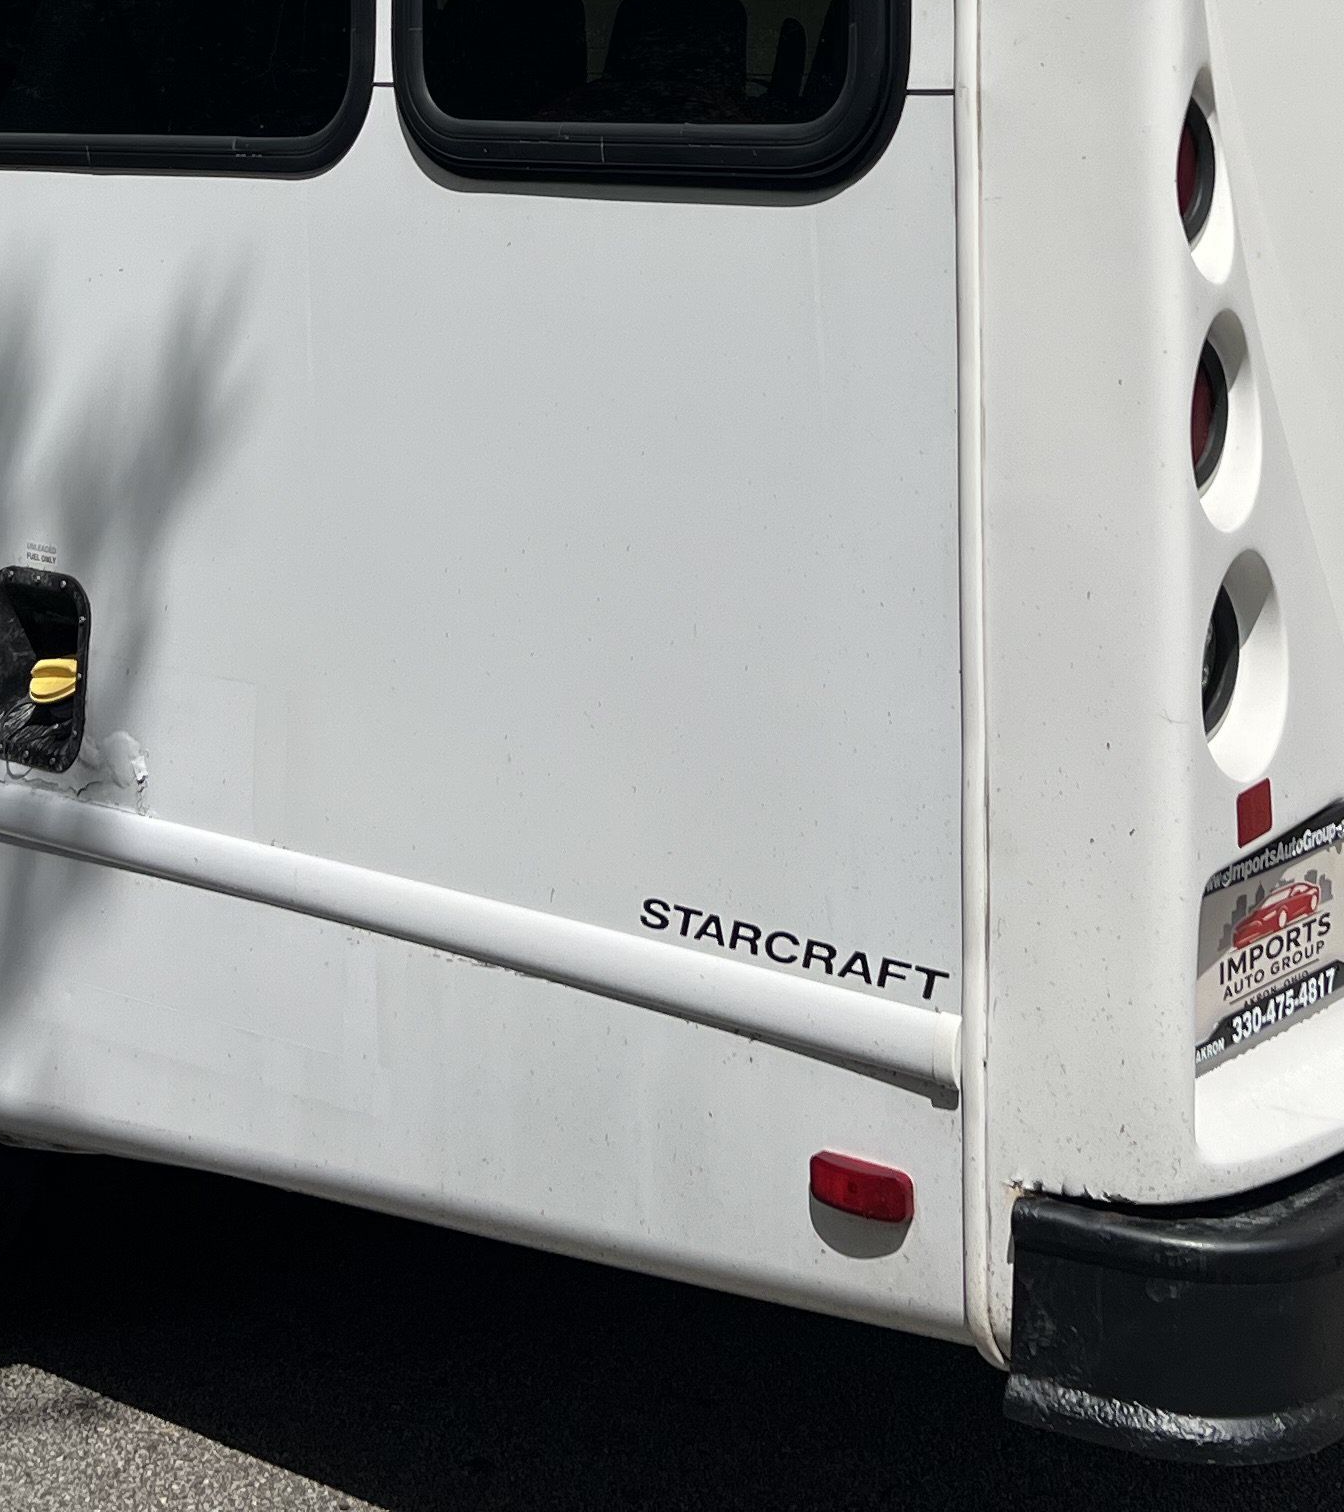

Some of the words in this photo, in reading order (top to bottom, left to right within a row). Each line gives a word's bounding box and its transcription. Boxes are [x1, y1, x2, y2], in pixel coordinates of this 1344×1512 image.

[639, 897, 951, 1000] STARCRAFT
[1219, 911, 1332, 986] IMPORTS
[1223, 968, 1265, 1002] AUTO
[1270, 939, 1325, 976] GROUP
[1195, 1036, 1225, 1065] AKRON
[1231, 967, 1336, 1044] 330-475-4817
